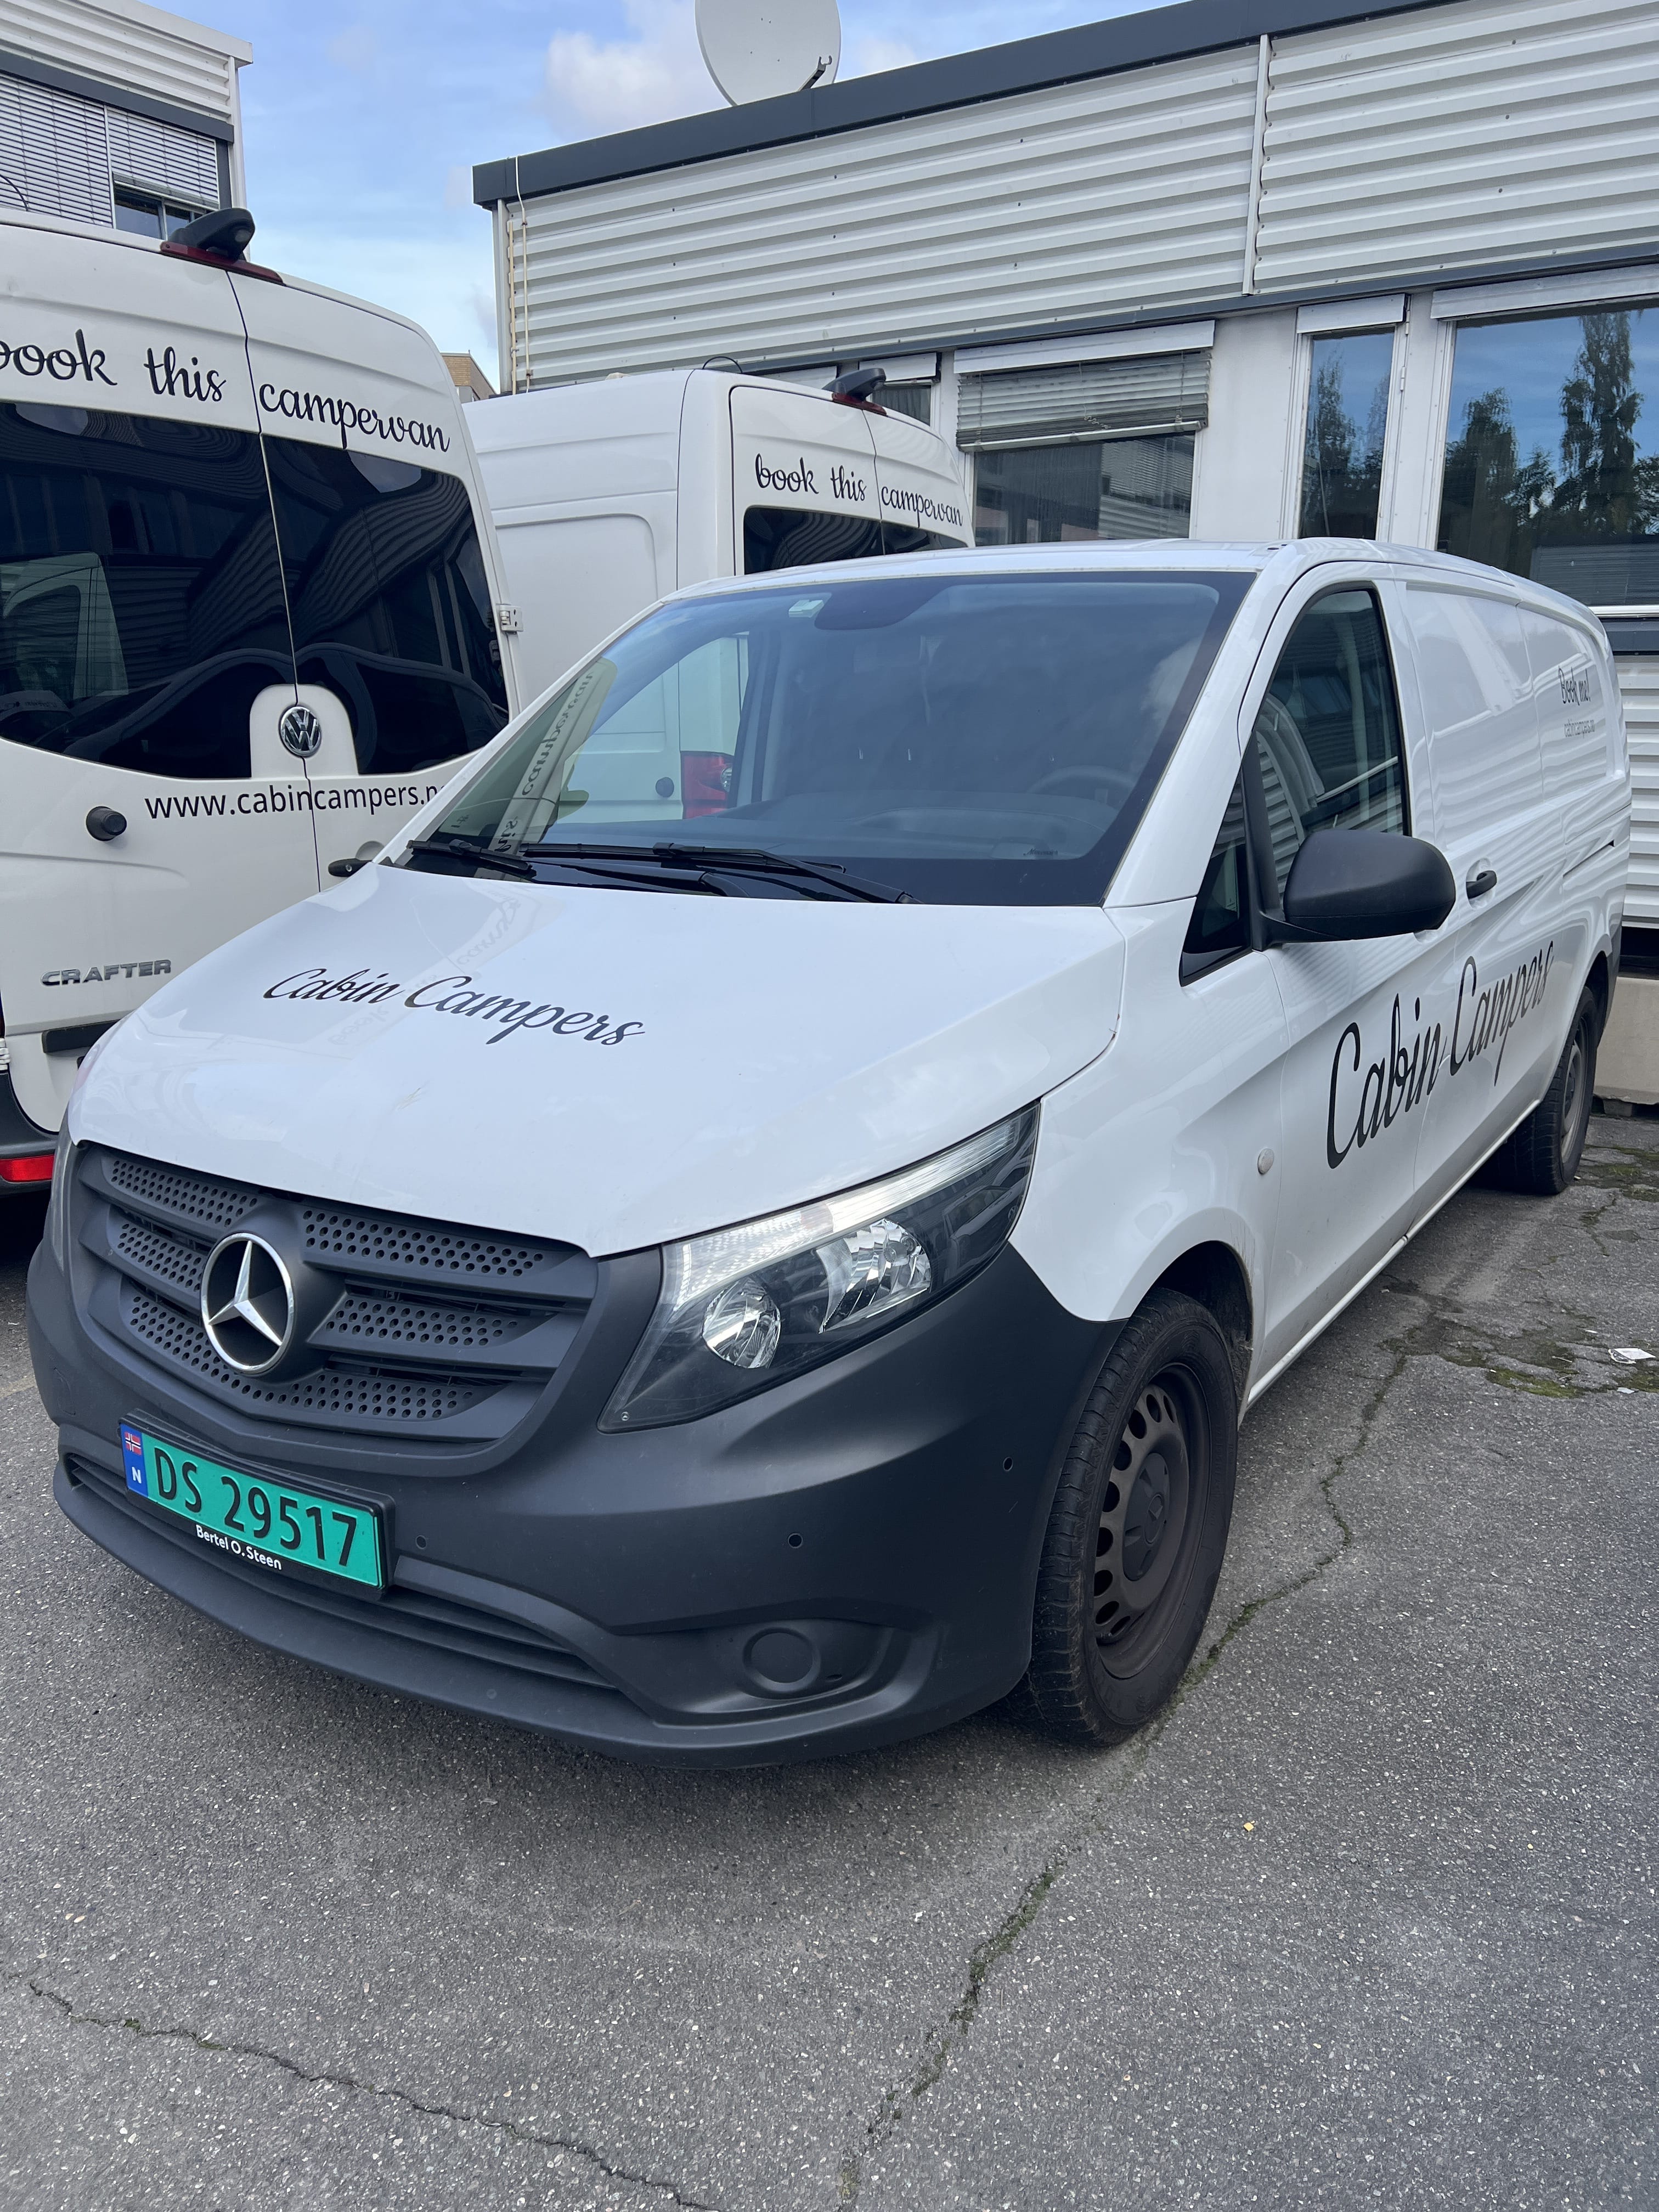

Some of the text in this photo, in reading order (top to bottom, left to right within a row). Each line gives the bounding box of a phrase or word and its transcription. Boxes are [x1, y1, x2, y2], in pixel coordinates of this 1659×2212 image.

[144, 346, 226, 402] this
[259, 383, 450, 452] campervan
[755, 453, 963, 528] book this campervan
[145, 785, 445, 819] www.cabincampers.n
[40, 960, 171, 987] CRAFTER
[263, 968, 405, 1005] Cabin
[404, 976, 645, 1046] Campers
[1327, 940, 1554, 1169] Cabin Campers
[131, 1465, 142, 1484] N
[154, 1447, 357, 1567] DS 29517
[196, 1525, 283, 1571] Bertel O. Steen
